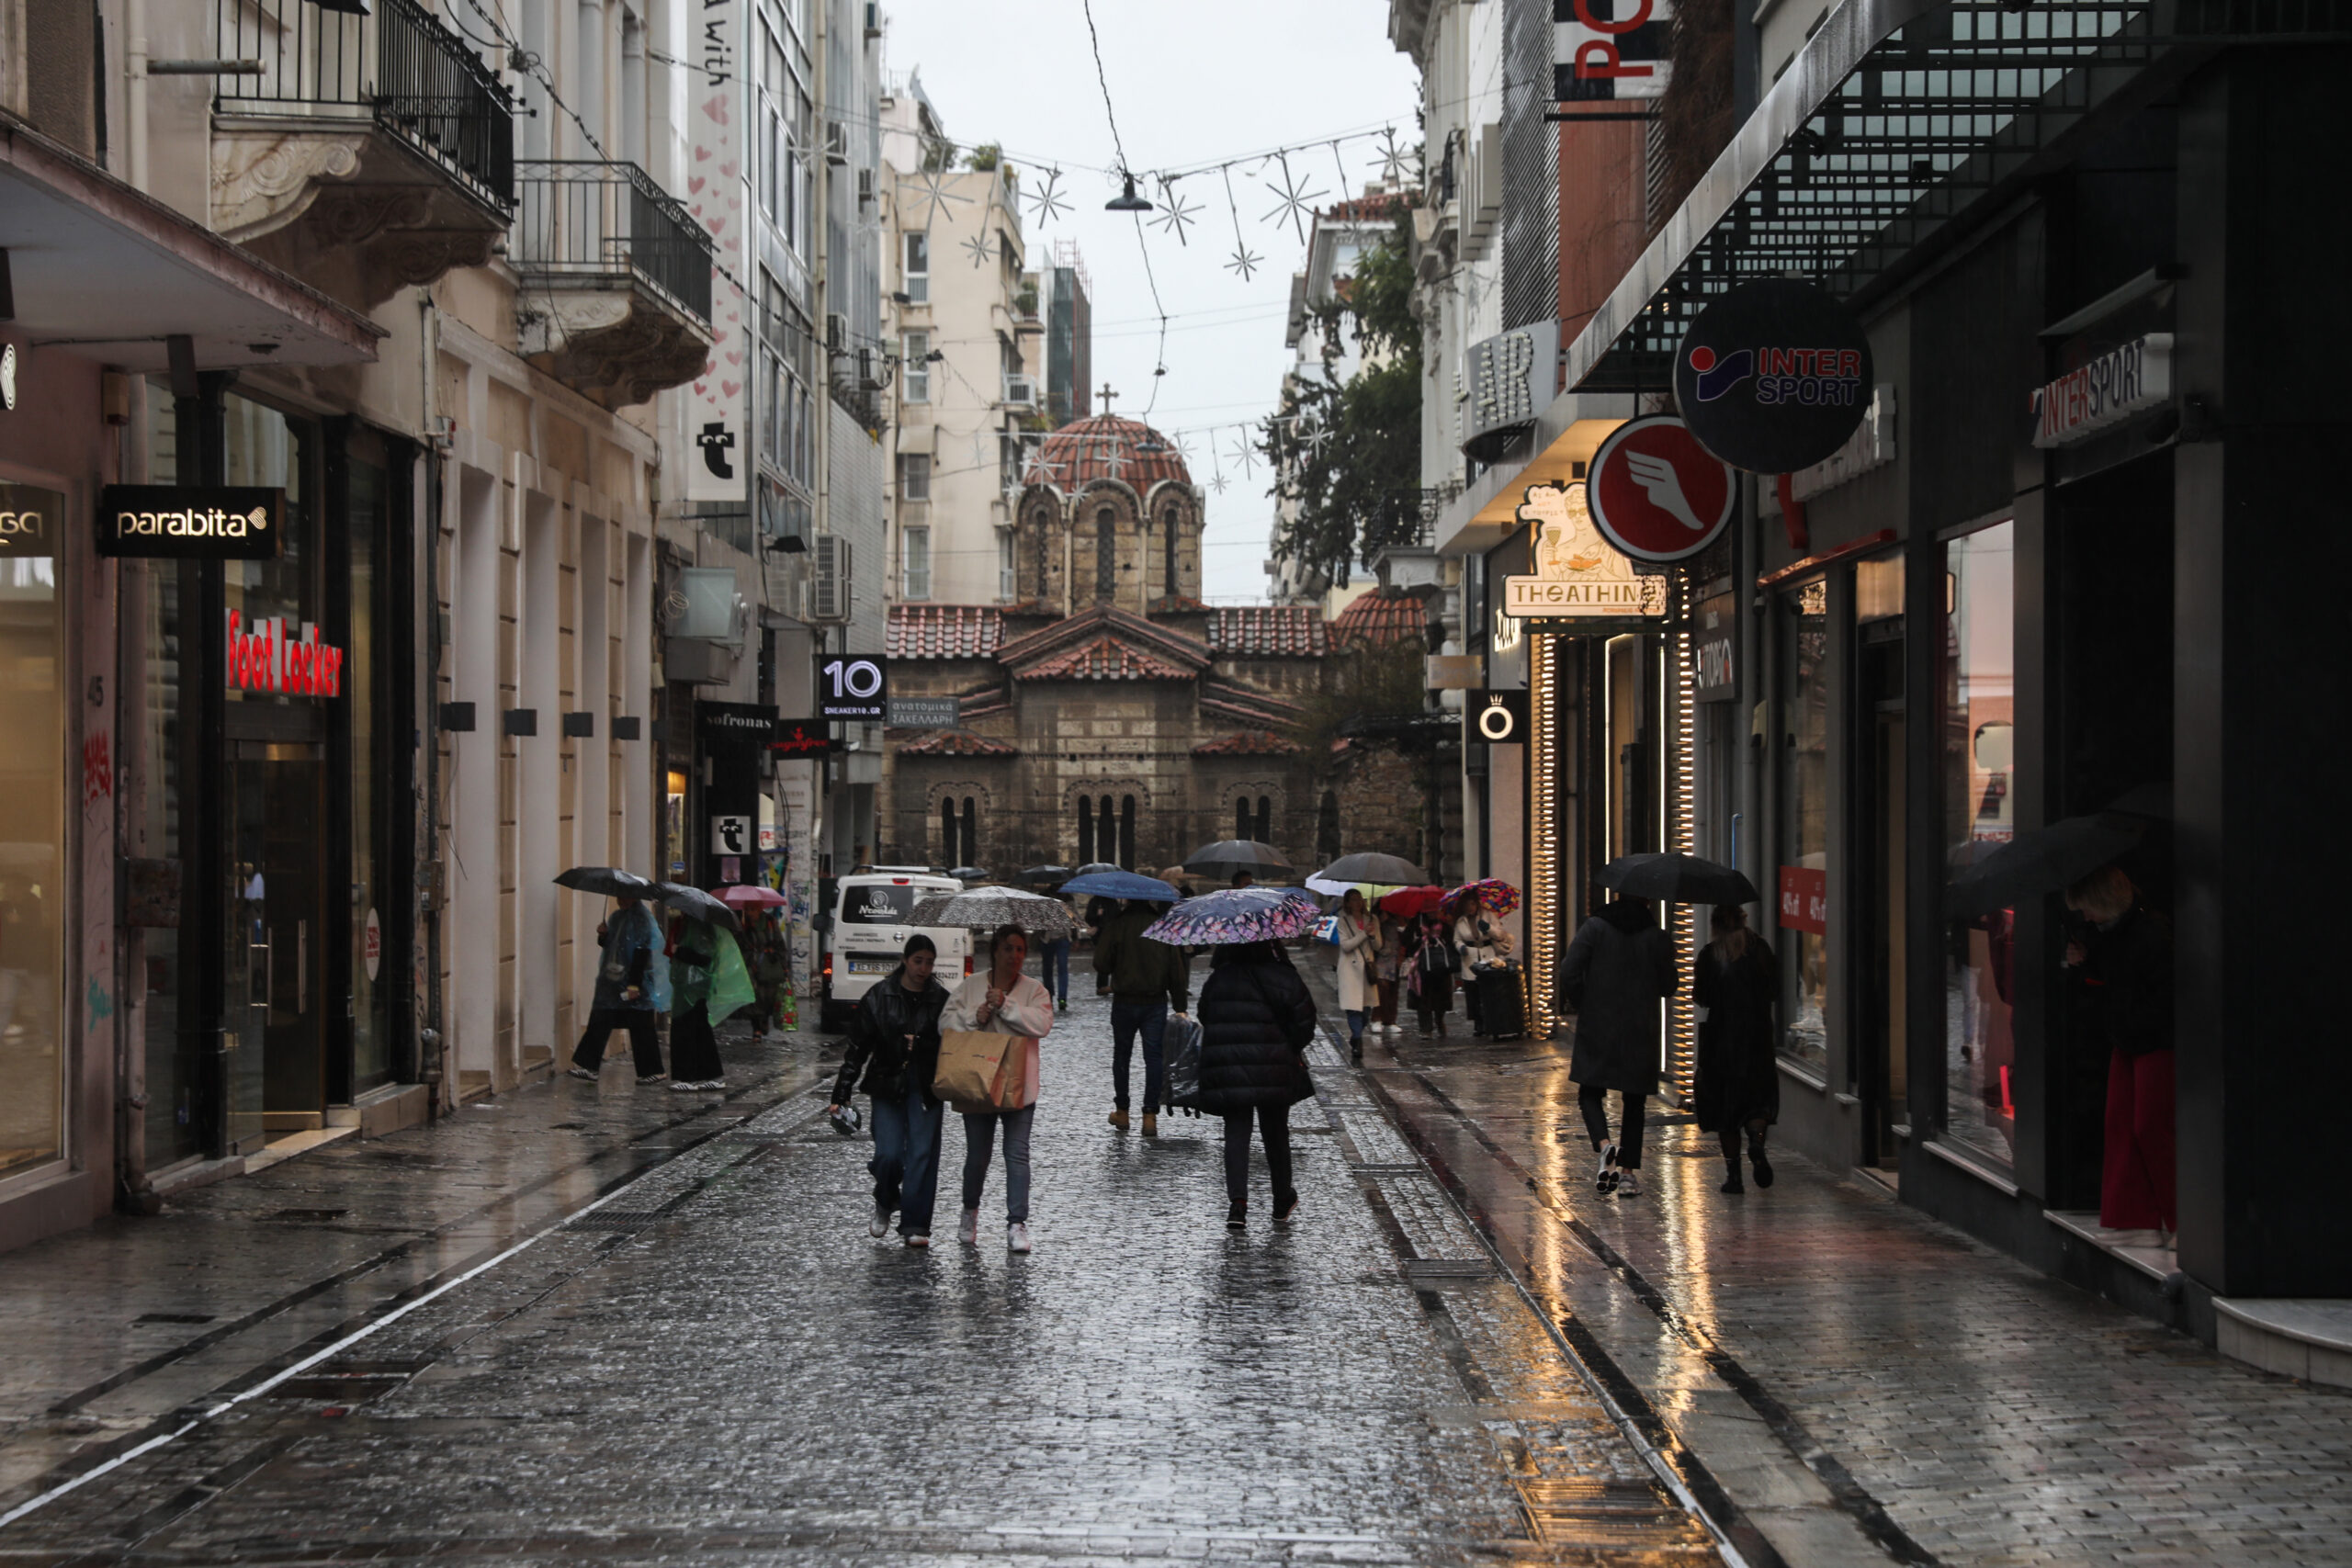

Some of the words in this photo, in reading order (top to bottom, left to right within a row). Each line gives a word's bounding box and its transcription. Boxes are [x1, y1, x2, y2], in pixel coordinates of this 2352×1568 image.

[704, 20, 731, 86] with
[1758, 347, 1860, 378] INTER
[1756, 376, 1860, 406] SPORT
[2041, 336, 2145, 438] INTERSPORT
[118, 508, 246, 538] parabita
[823, 660, 882, 698] 10
[707, 713, 772, 728] sofronas
[892, 715, 953, 725] ΣΑΚΕΛΛΑΡΗ
